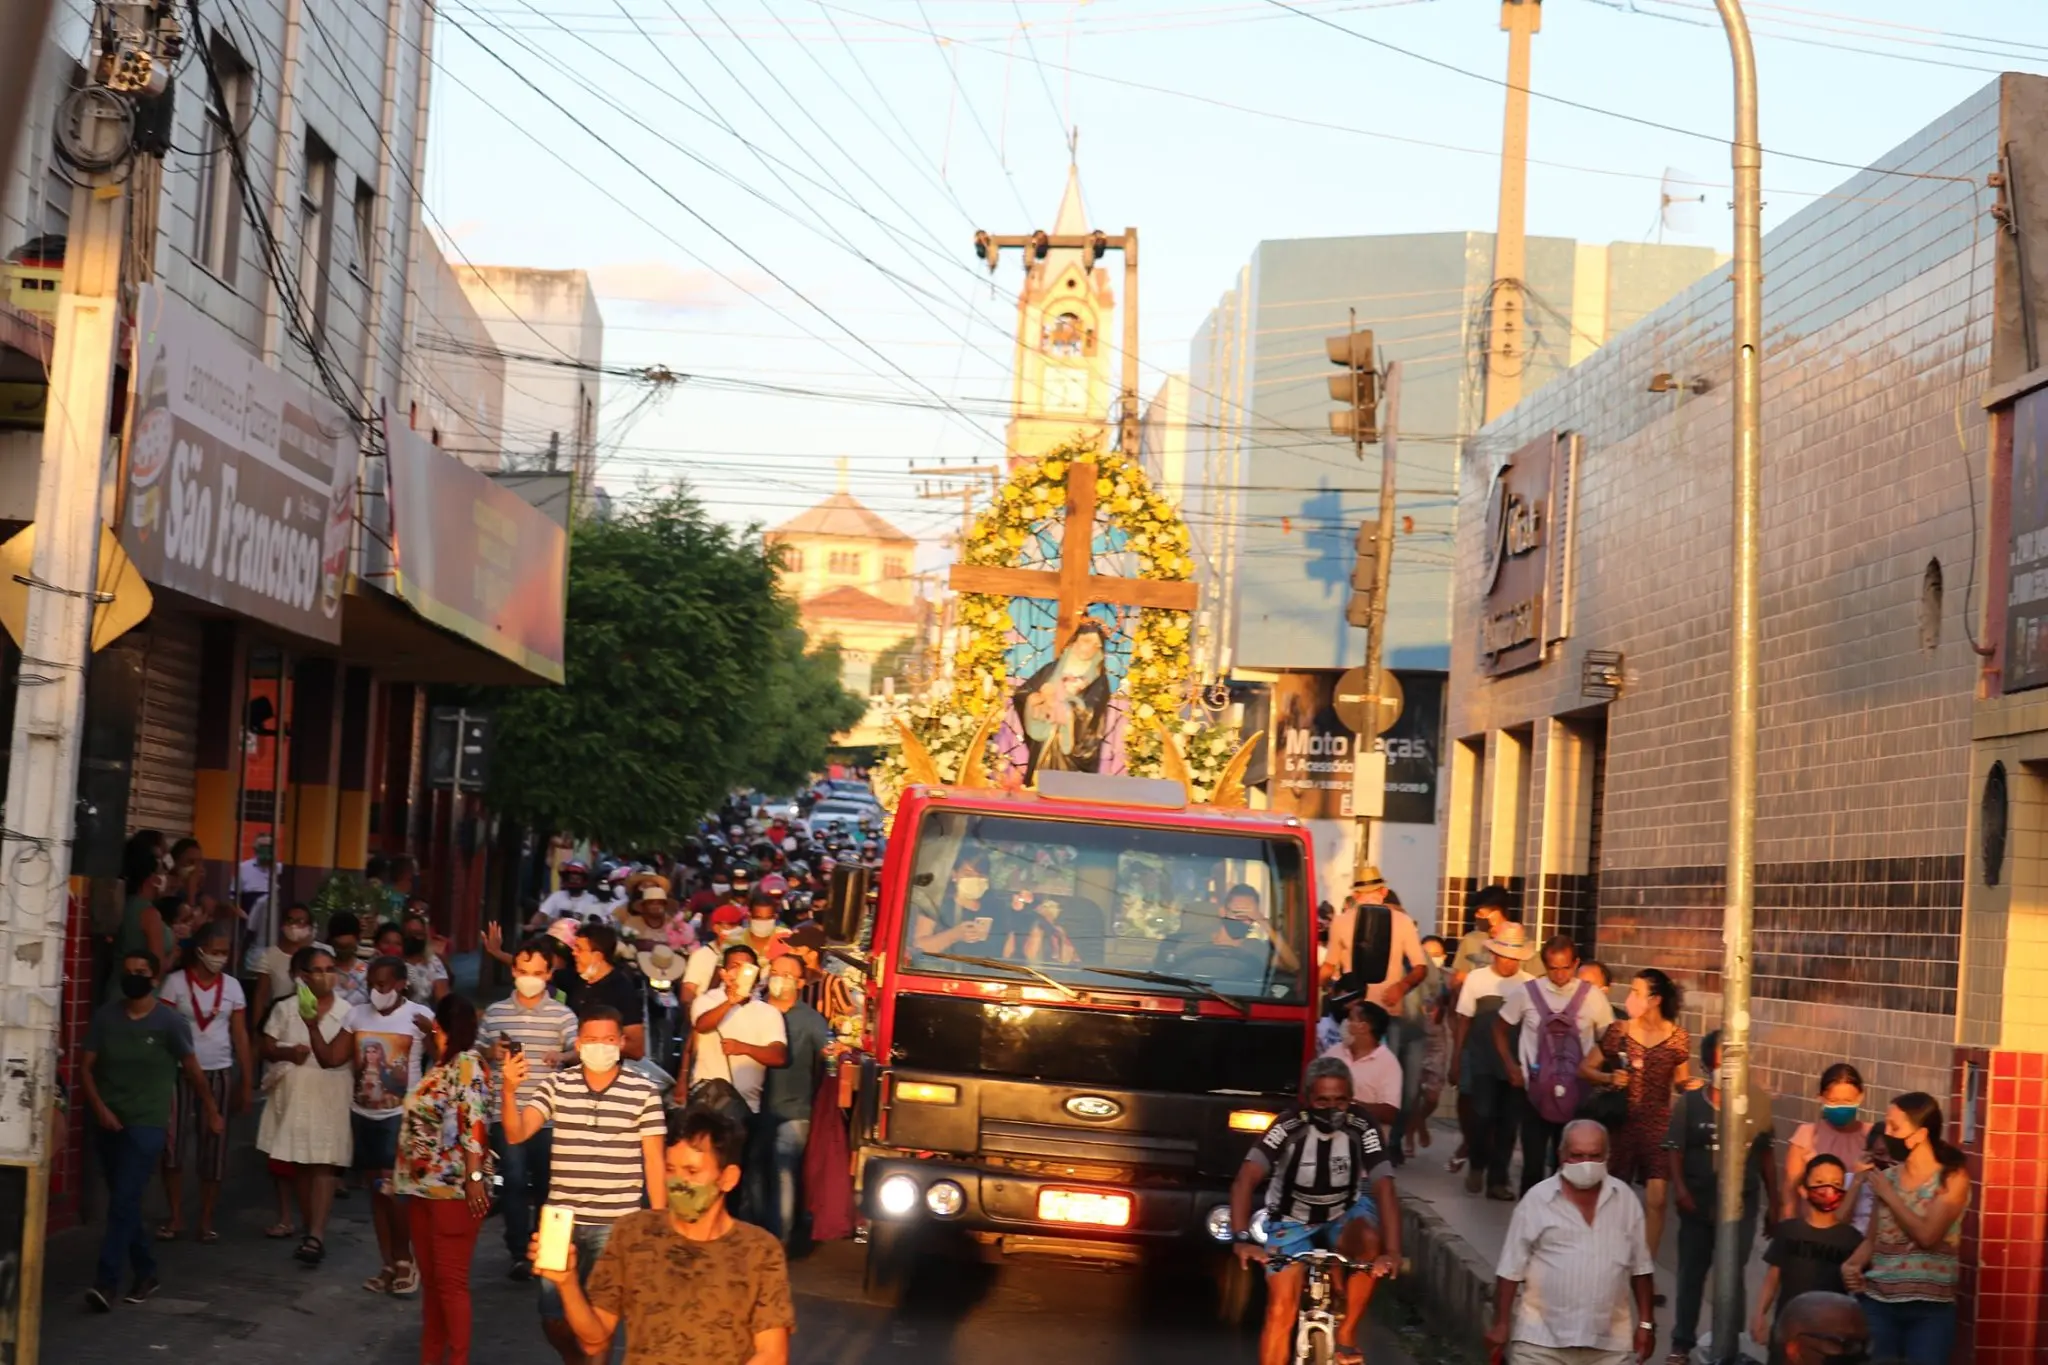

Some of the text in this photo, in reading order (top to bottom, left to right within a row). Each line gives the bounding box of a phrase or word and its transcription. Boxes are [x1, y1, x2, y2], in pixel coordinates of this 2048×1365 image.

[164, 439, 212, 570] São
[211, 463, 319, 612] Francisco
[1285, 728, 1348, 756] Moto
[1297, 758, 1355, 774] Acessório
